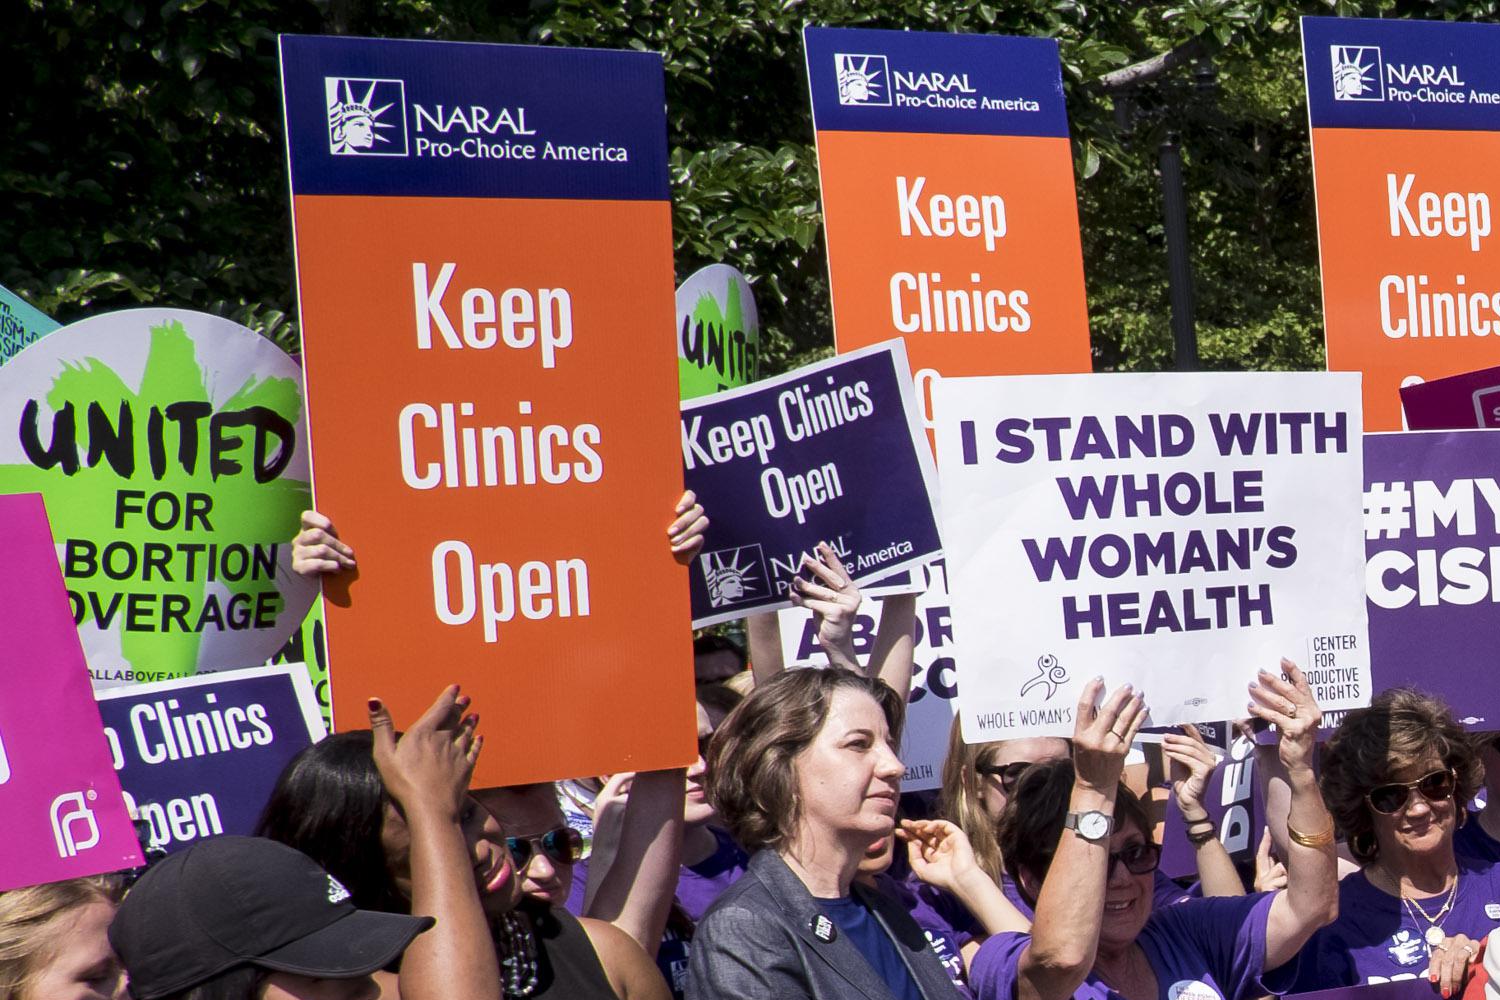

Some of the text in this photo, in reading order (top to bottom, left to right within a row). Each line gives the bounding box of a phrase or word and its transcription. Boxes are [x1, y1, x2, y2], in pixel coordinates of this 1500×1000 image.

[893, 71, 976, 93] NARAL
[1386, 64, 1465, 86] NARAL
[1388, 87, 1465, 104] Pro-Choice
[413, 104, 536, 135] NARAL
[896, 93, 1040, 112] Pro-Choice America
[415, 138, 628, 162] Pro-Choice America
[896, 176, 1007, 252] Keep
[1386, 173, 1491, 251] Keep
[412, 262, 572, 368] Keep
[890, 272, 1031, 334] Clinics
[19, 399, 296, 484] UNITED
[399, 401, 603, 489] Clinics
[680, 414, 776, 470] Keep
[778, 375, 874, 442] Clinics
[960, 411, 1348, 465] I STAND WITH
[114, 490, 214, 531] FOR
[760, 462, 844, 524] Open
[1056, 470, 1265, 521] WHOLE
[857, 540, 913, 571] America
[1021, 525, 1298, 582] WOMAN'S
[432, 540, 591, 643] Open
[1062, 584, 1274, 640] HEALTH
[1313, 634, 1357, 651] CENTER
[1314, 653, 1335, 668] FOR
[977, 711, 1014, 730] WHOLE
[1019, 707, 1072, 726] WOMAN'S
[1317, 684, 1360, 701] RIGHTS
[130, 693, 274, 764] Clinics
